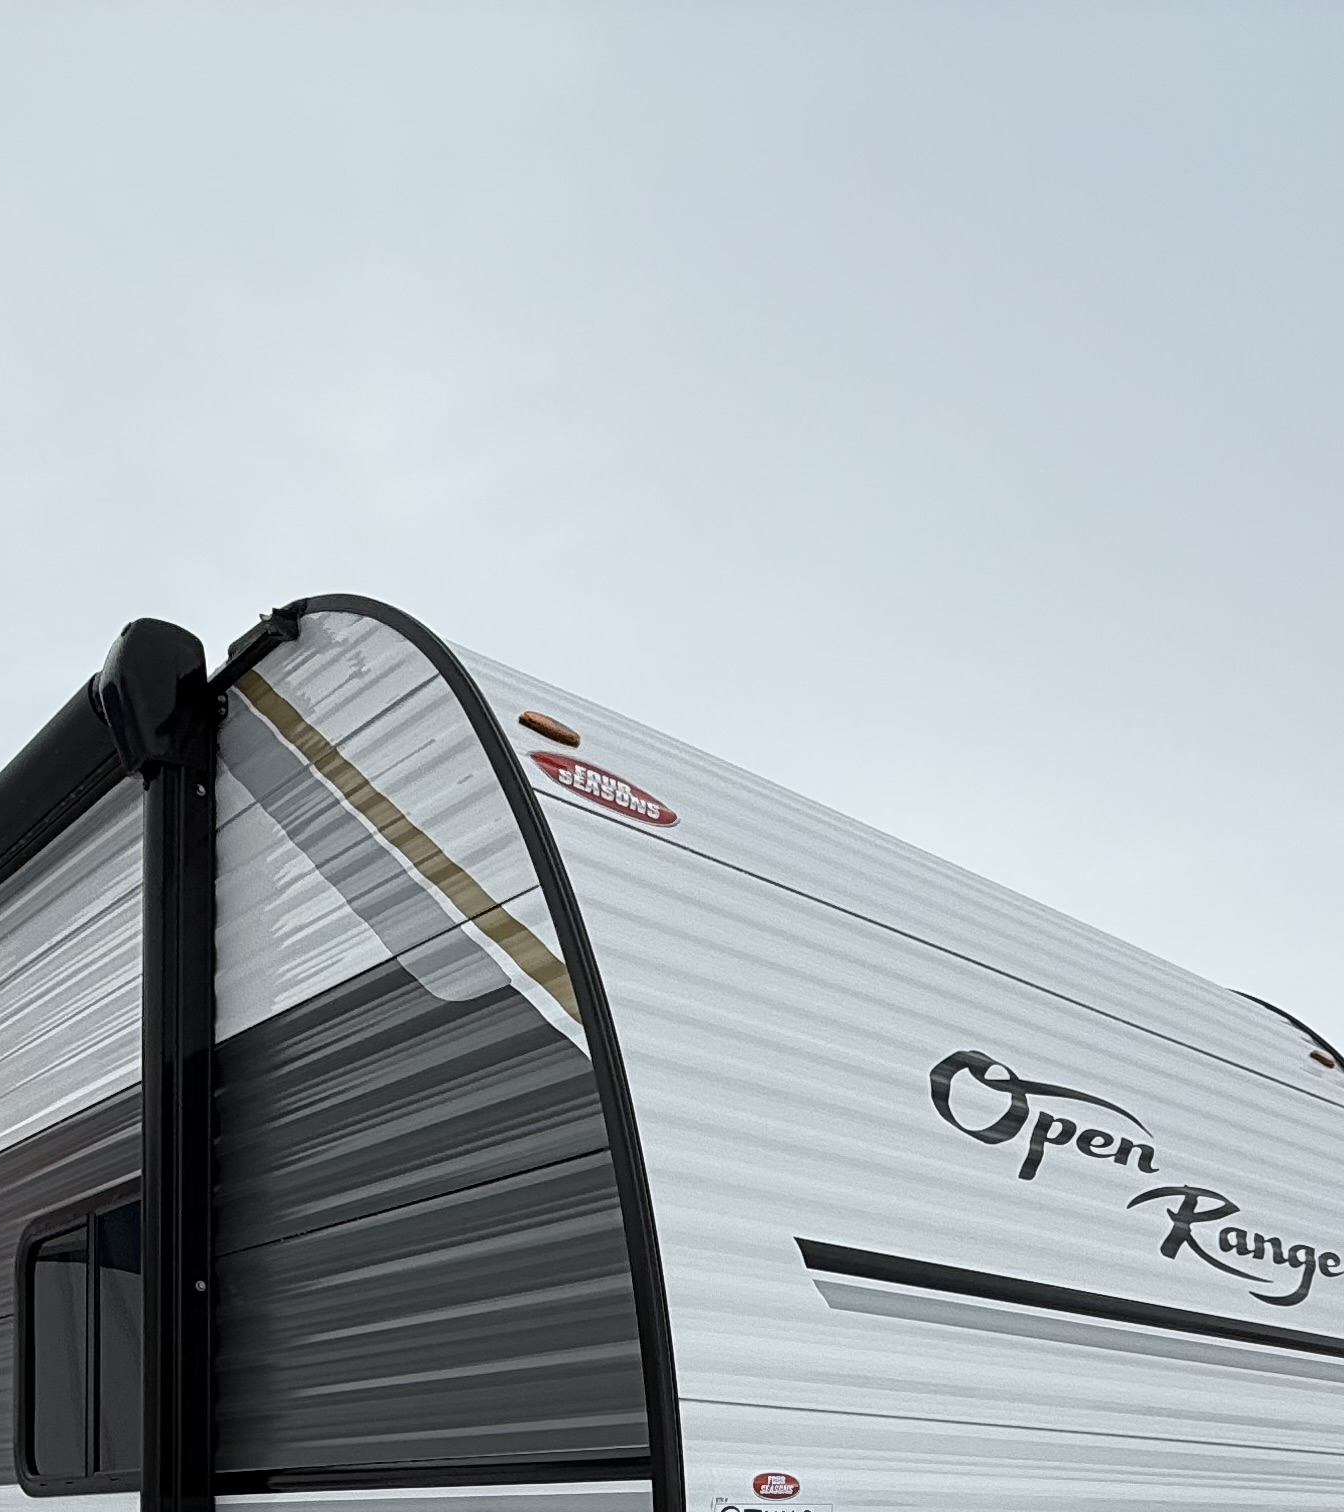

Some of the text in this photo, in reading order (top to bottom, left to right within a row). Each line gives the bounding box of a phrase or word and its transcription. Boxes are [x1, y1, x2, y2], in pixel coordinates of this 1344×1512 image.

[558, 768, 661, 820] SEASONS
[574, 764, 632, 796] FOUR
[929, 1049, 1160, 1182] Open
